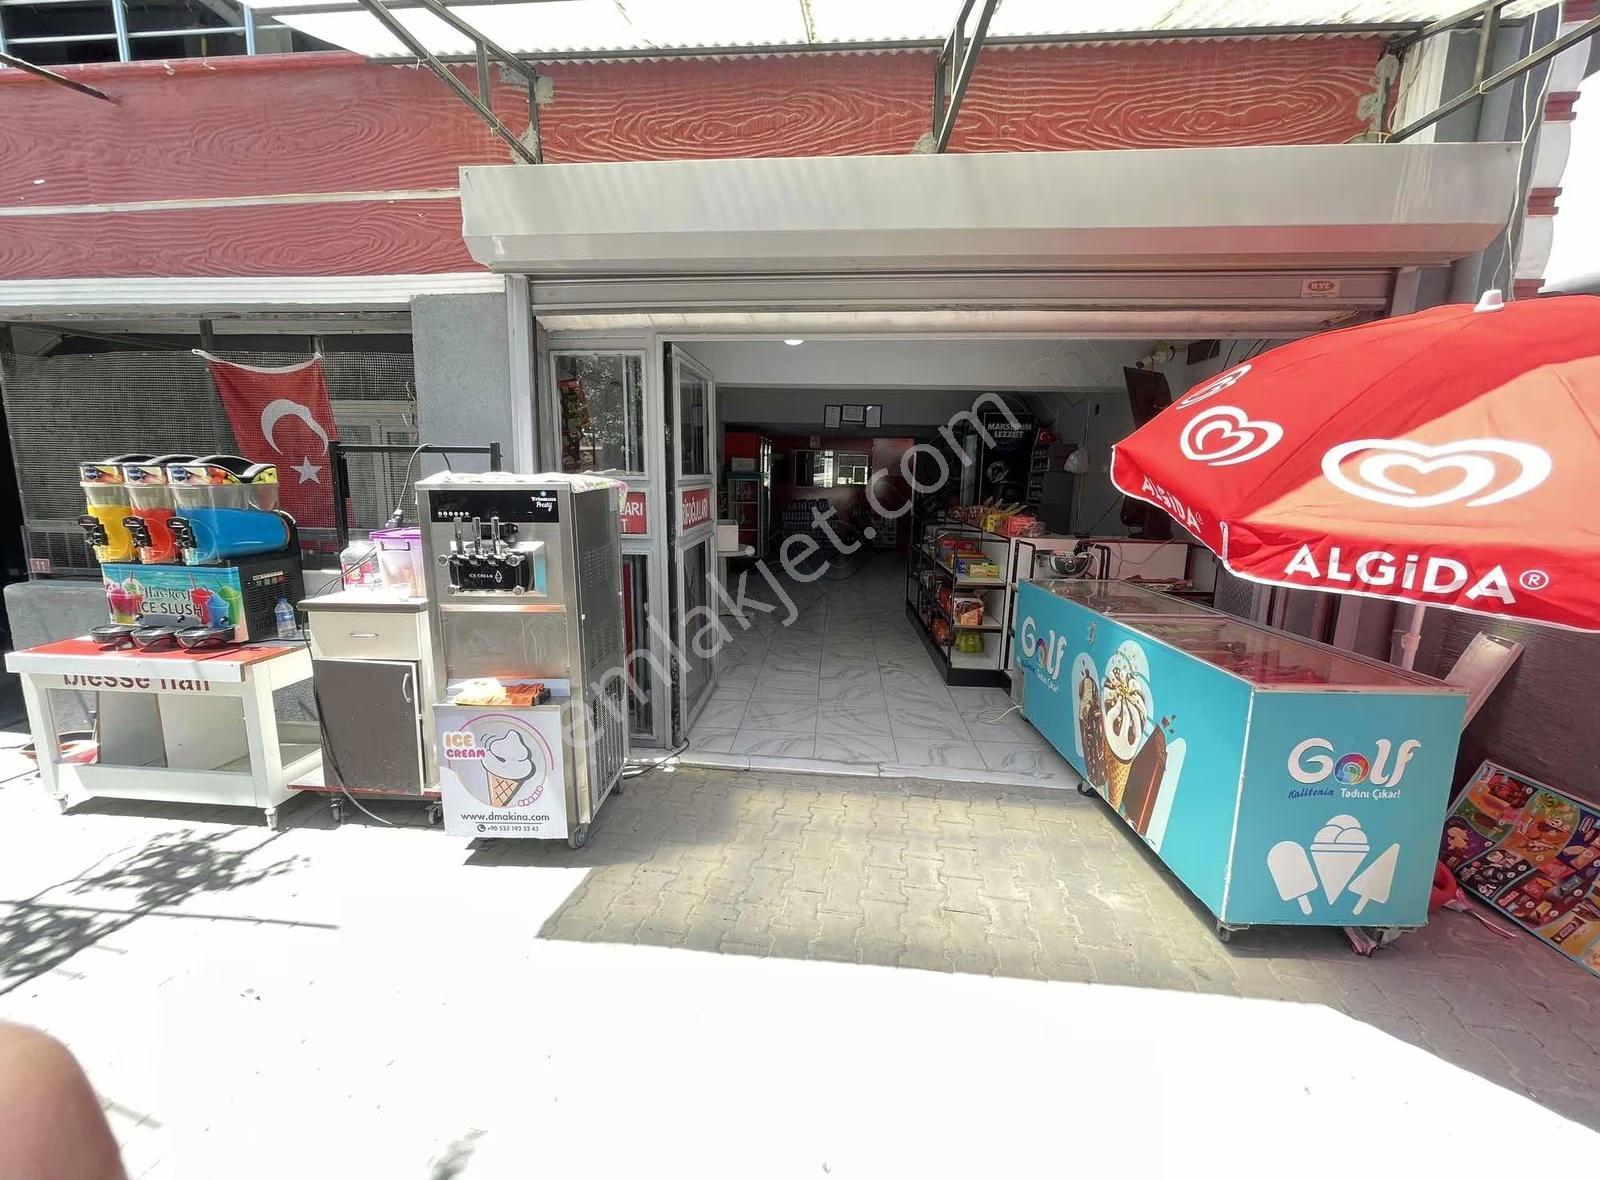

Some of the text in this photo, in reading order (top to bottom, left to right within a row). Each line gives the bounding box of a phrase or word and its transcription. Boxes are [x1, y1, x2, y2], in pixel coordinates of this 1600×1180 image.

[160, 602, 203, 616] SLUSH
[1021, 616, 1067, 680] Golf
[445, 734, 472, 747] ICE
[446, 748, 486, 758] CREAM
[1287, 737, 1421, 788] Golf
[1288, 787, 1401, 801] Kalitenin Tadını Çıkar!
